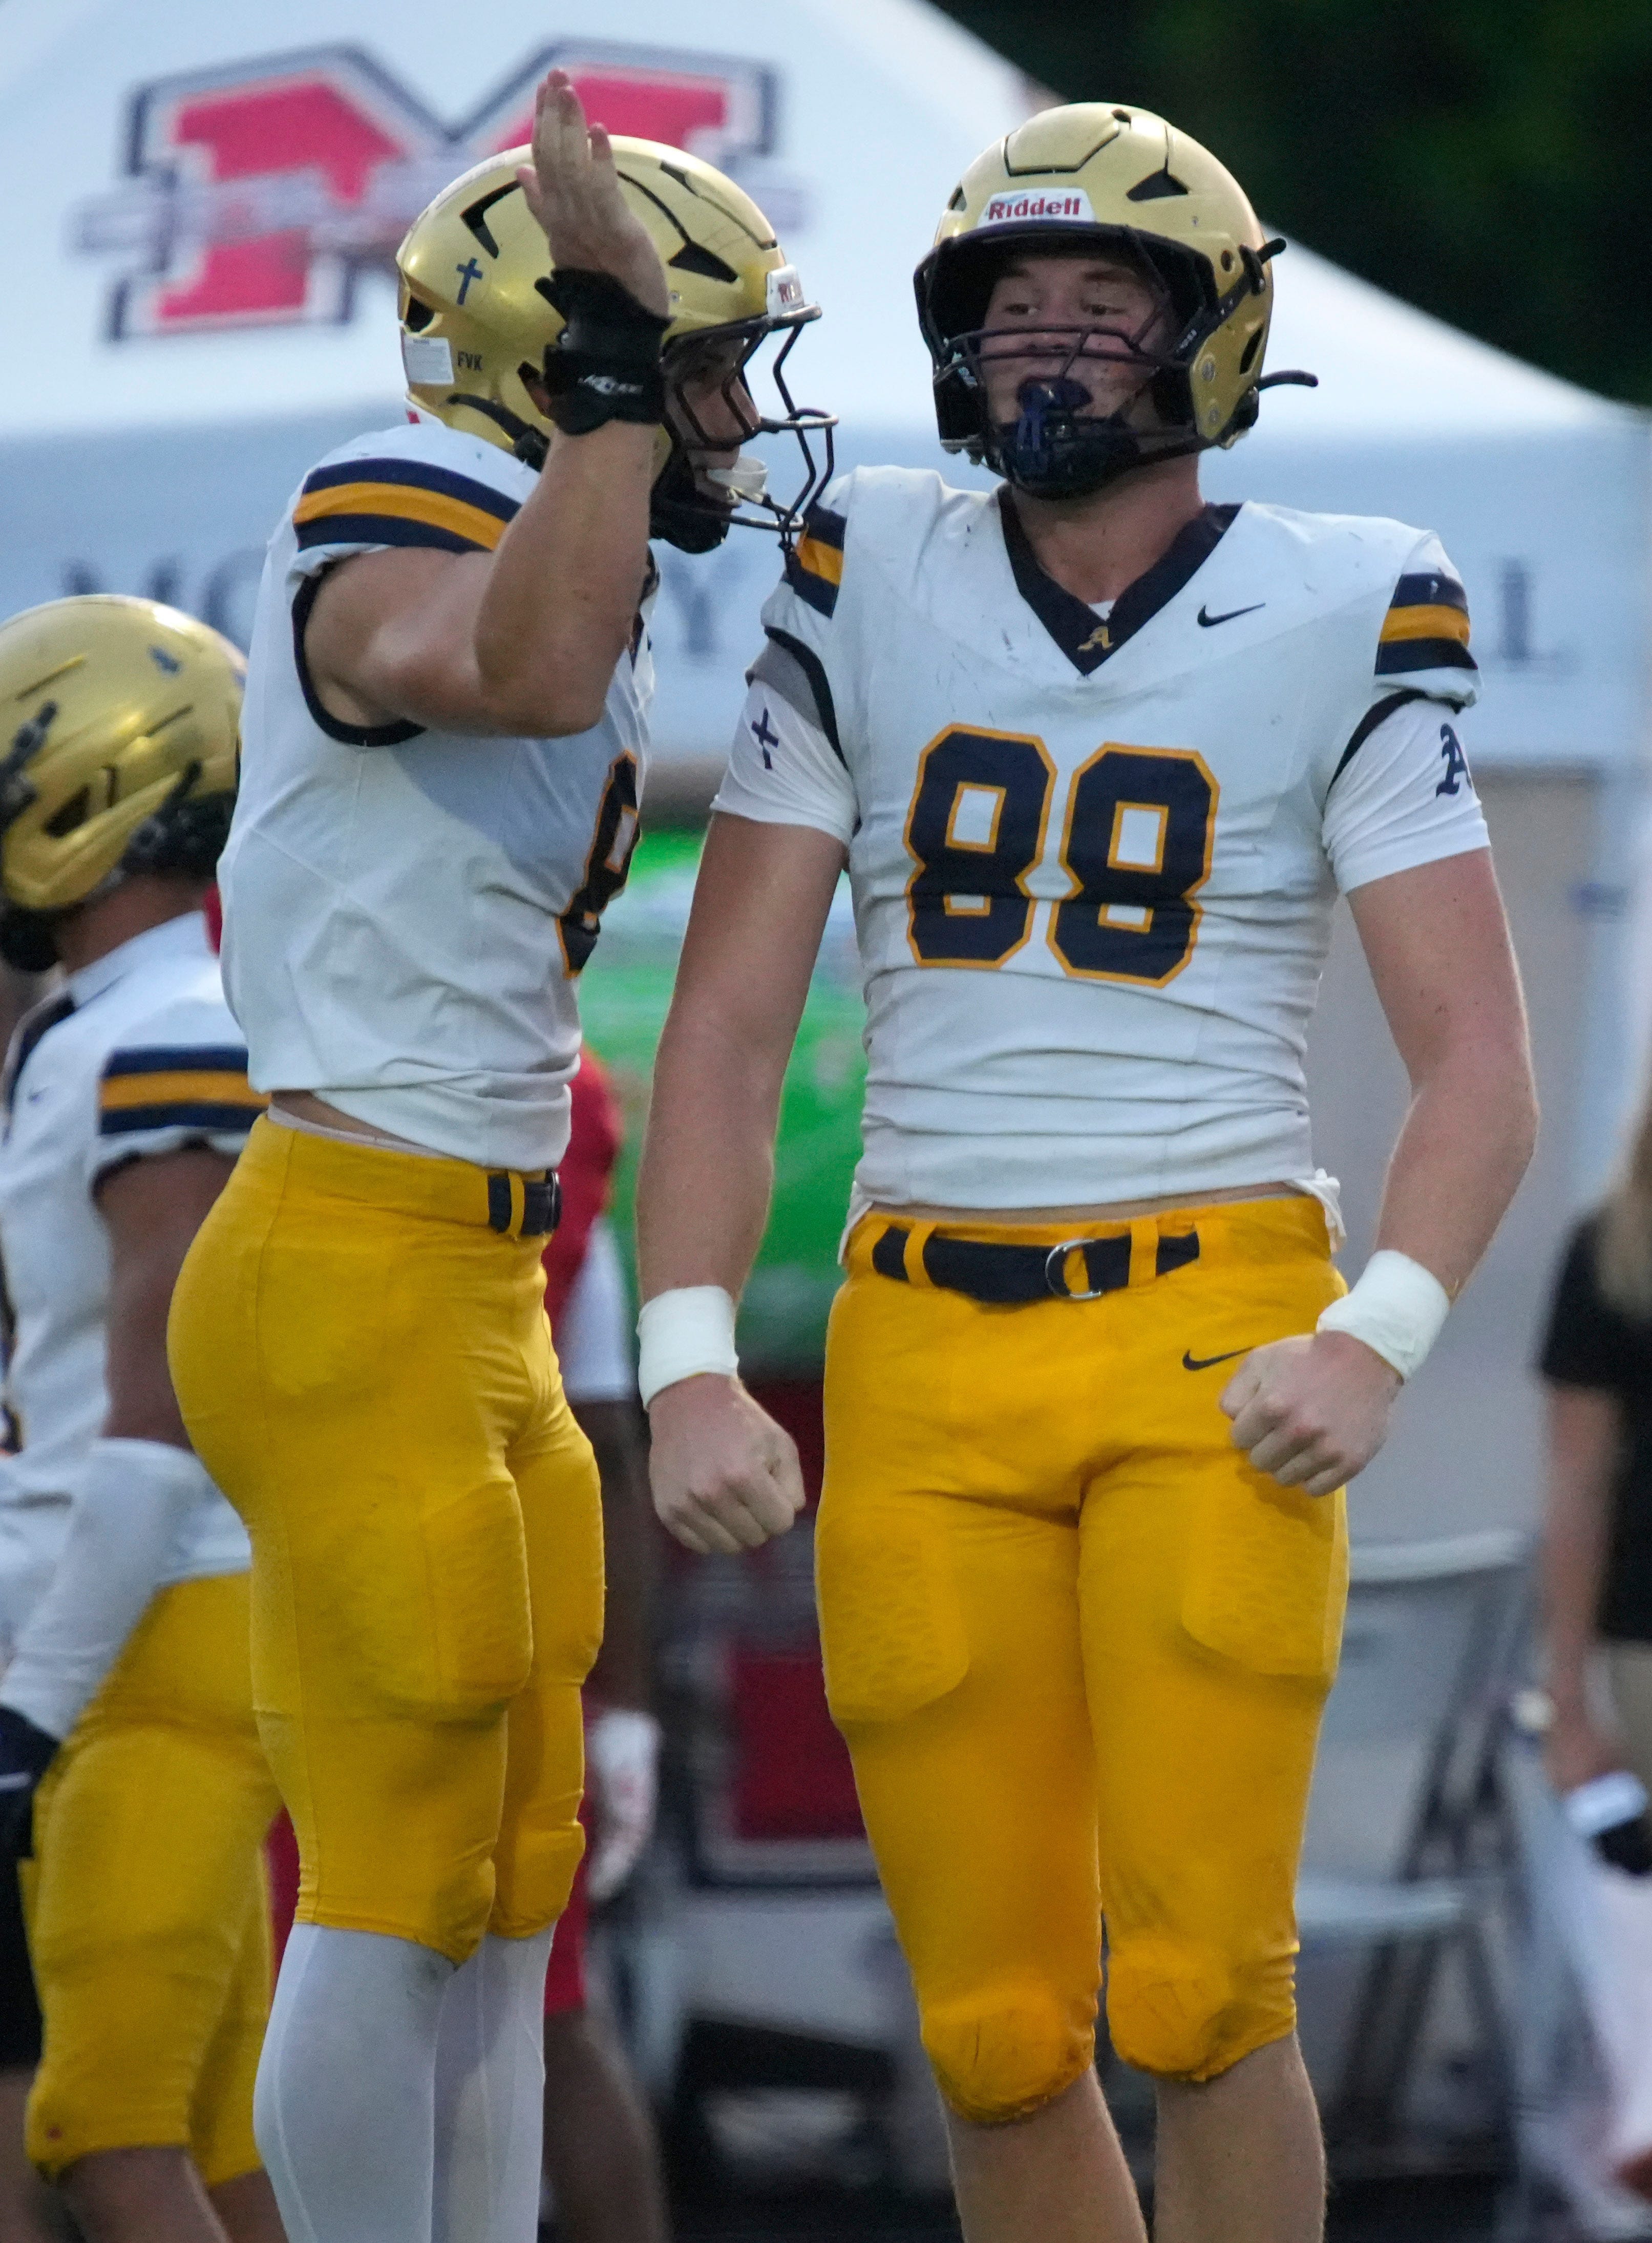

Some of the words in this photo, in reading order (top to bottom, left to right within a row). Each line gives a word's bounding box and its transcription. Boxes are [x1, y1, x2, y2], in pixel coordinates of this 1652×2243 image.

[106, 37, 782, 342] M
[988, 197, 1082, 220] Riddell
[1077, 626, 1114, 650] A
[1436, 723, 1473, 797] A
[903, 722, 1220, 989] 88
